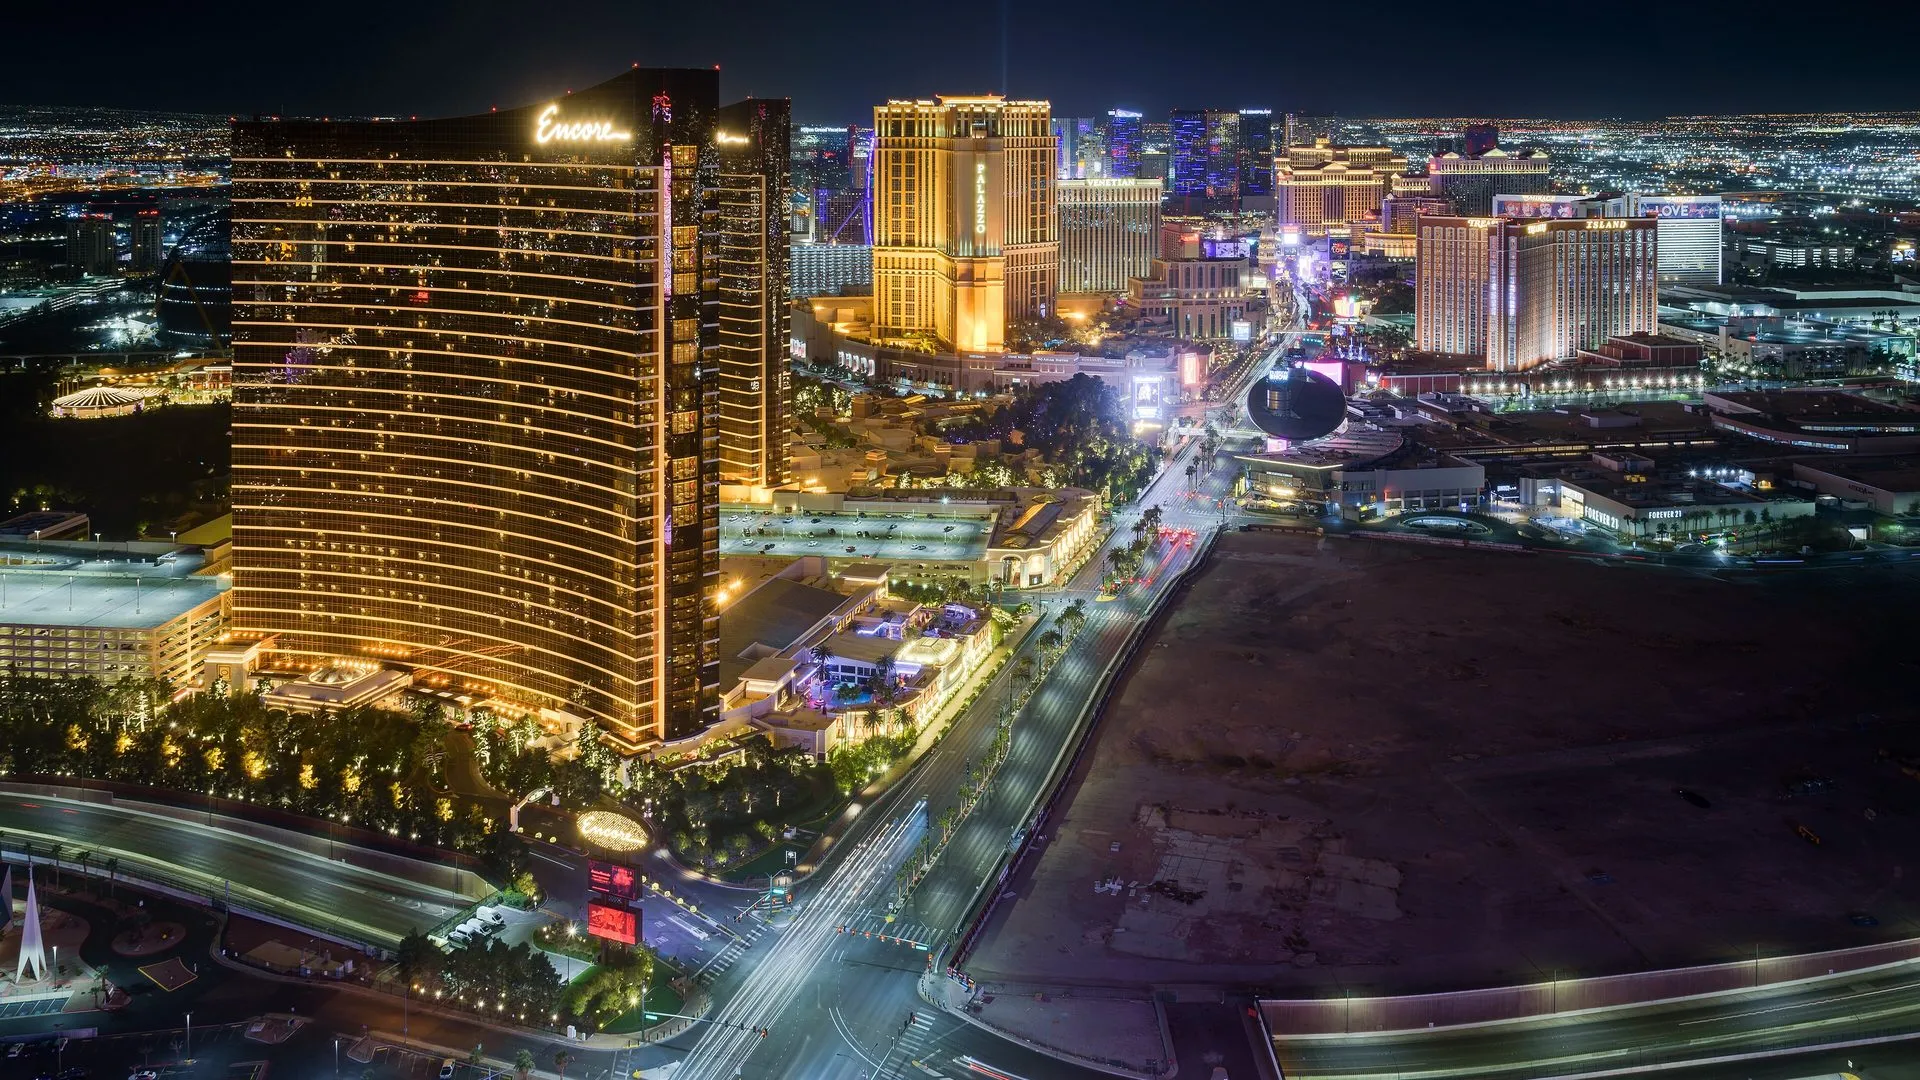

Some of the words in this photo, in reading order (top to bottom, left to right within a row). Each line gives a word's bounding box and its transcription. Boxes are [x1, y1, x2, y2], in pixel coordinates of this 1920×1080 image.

[537, 105, 631, 143] Encore
[1087, 178, 1136, 187] VENETIAN
[976, 163, 986, 234] PALAZZO
[1656, 205, 1688, 217] LOVE
[1586, 220, 1627, 229] ISLAND
[1585, 505, 1610, 526] FOREVER
[1611, 516, 1619, 530] 21
[1649, 511, 1674, 519] FOREVER
[1675, 510, 1682, 518] 21
